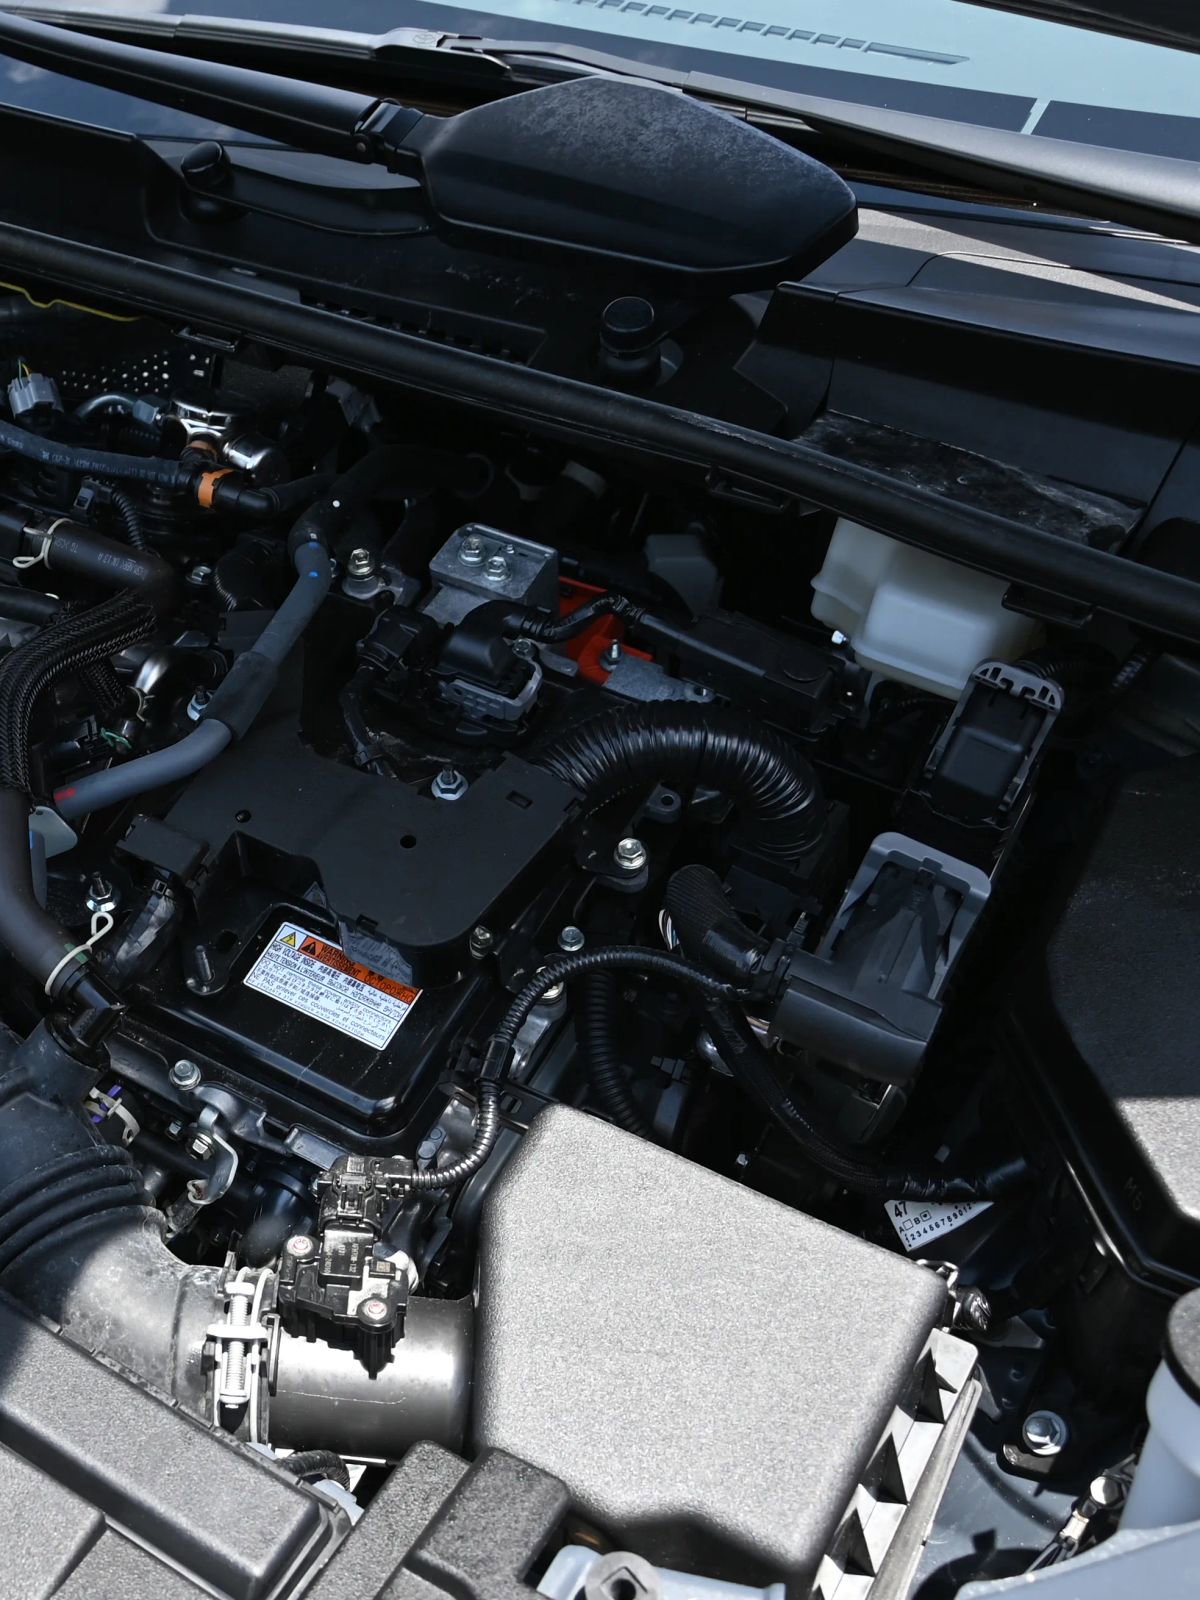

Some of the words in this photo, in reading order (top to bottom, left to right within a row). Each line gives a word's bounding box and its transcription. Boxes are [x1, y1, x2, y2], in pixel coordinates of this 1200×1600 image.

[281, 947, 302, 961] VOLTAGE
[279, 956, 297, 969] TENSION
[261, 976, 274, 986] PAS
[894, 1201, 908, 1217] 47
